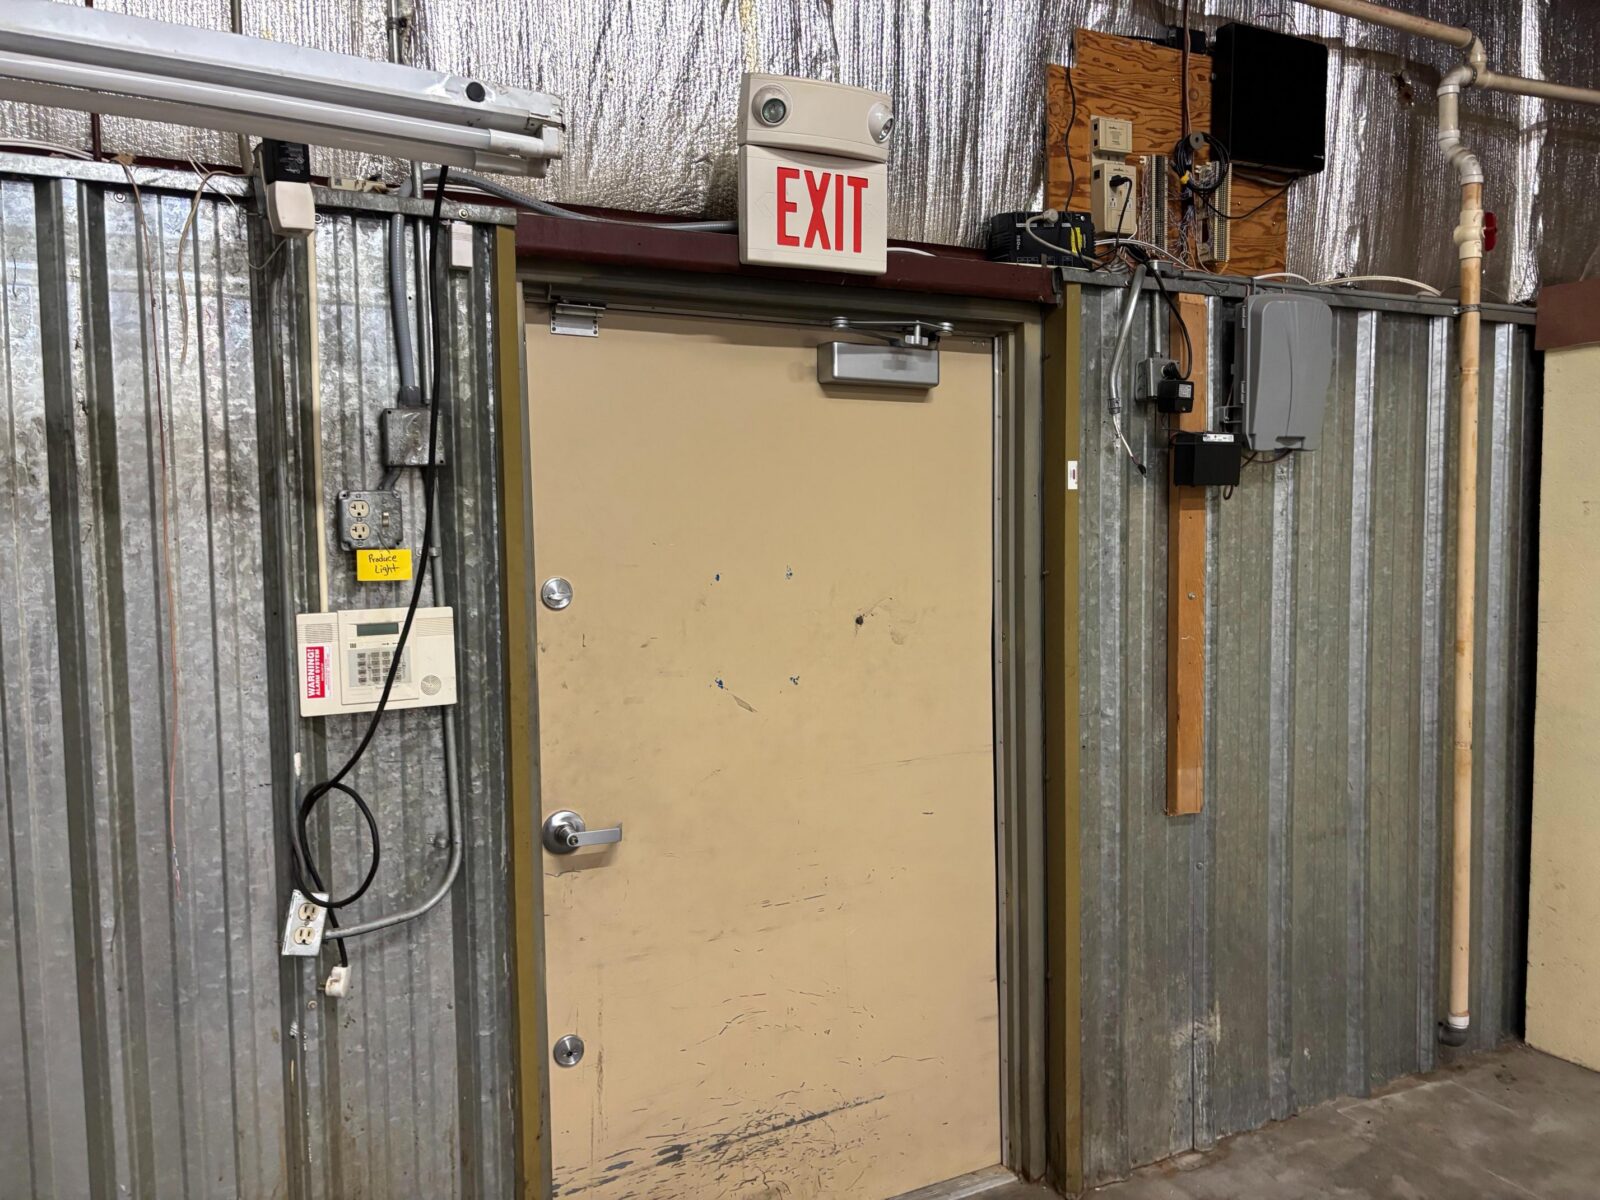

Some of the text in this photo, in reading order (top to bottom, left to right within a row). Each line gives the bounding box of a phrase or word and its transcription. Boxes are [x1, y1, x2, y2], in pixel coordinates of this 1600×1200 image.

[777, 166, 869, 253] EXIT
[368, 553, 399, 563] Produce
[374, 563, 400, 576] Light
[306, 648, 316, 697] WARNING!
